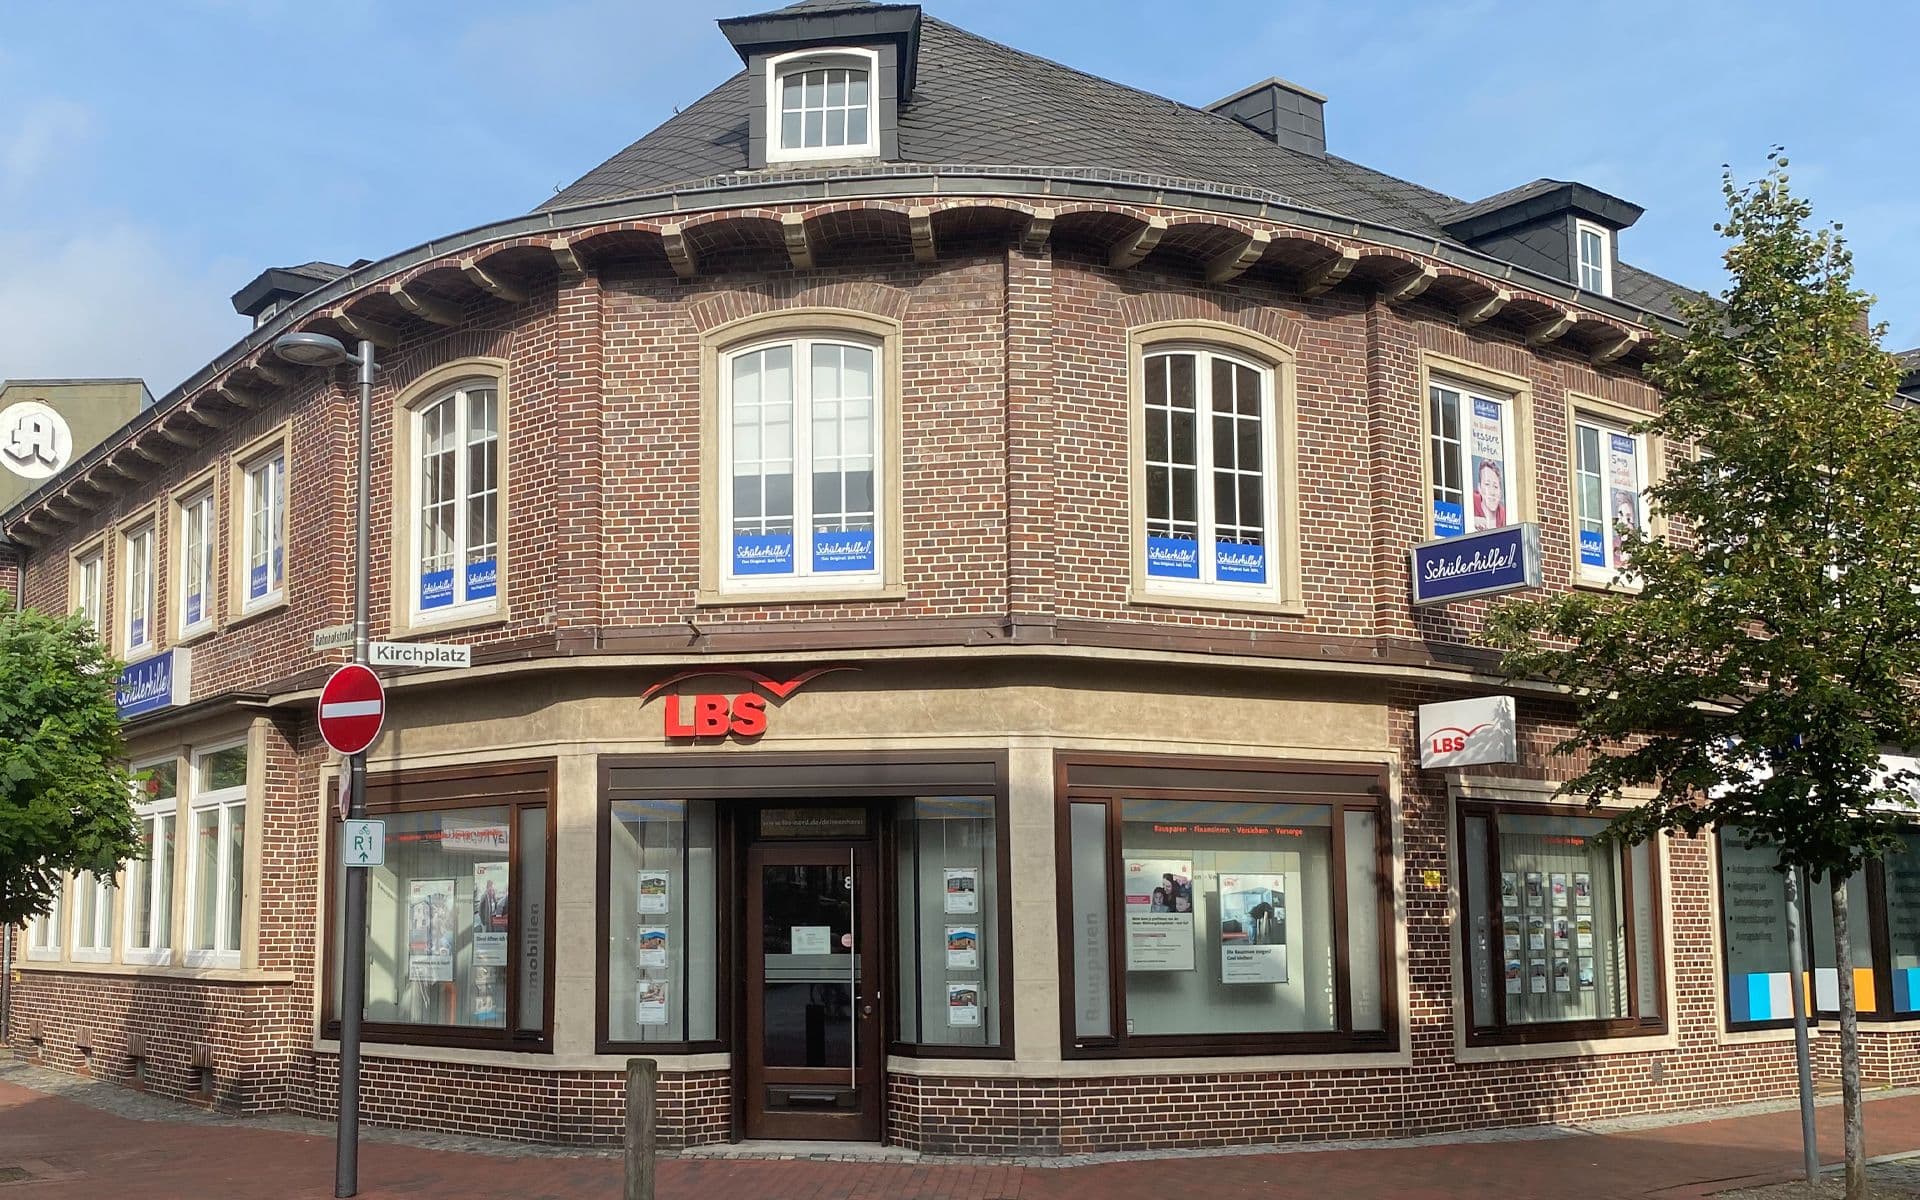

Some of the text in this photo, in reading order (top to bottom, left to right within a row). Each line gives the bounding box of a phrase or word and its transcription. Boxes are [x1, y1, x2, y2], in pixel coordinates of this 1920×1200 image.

[736, 544, 791, 559] Schülerhilfe!
[816, 541, 872, 557] Schülerhilfe!
[1424, 543, 1517, 579] Schülerhilfe!
[377, 645, 466, 665] Kirchplatz
[665, 692, 768, 738] LBS
[1433, 737, 1465, 754] LBS
[844, 876, 852, 889] 8
[526, 902, 540, 987] mobilien
